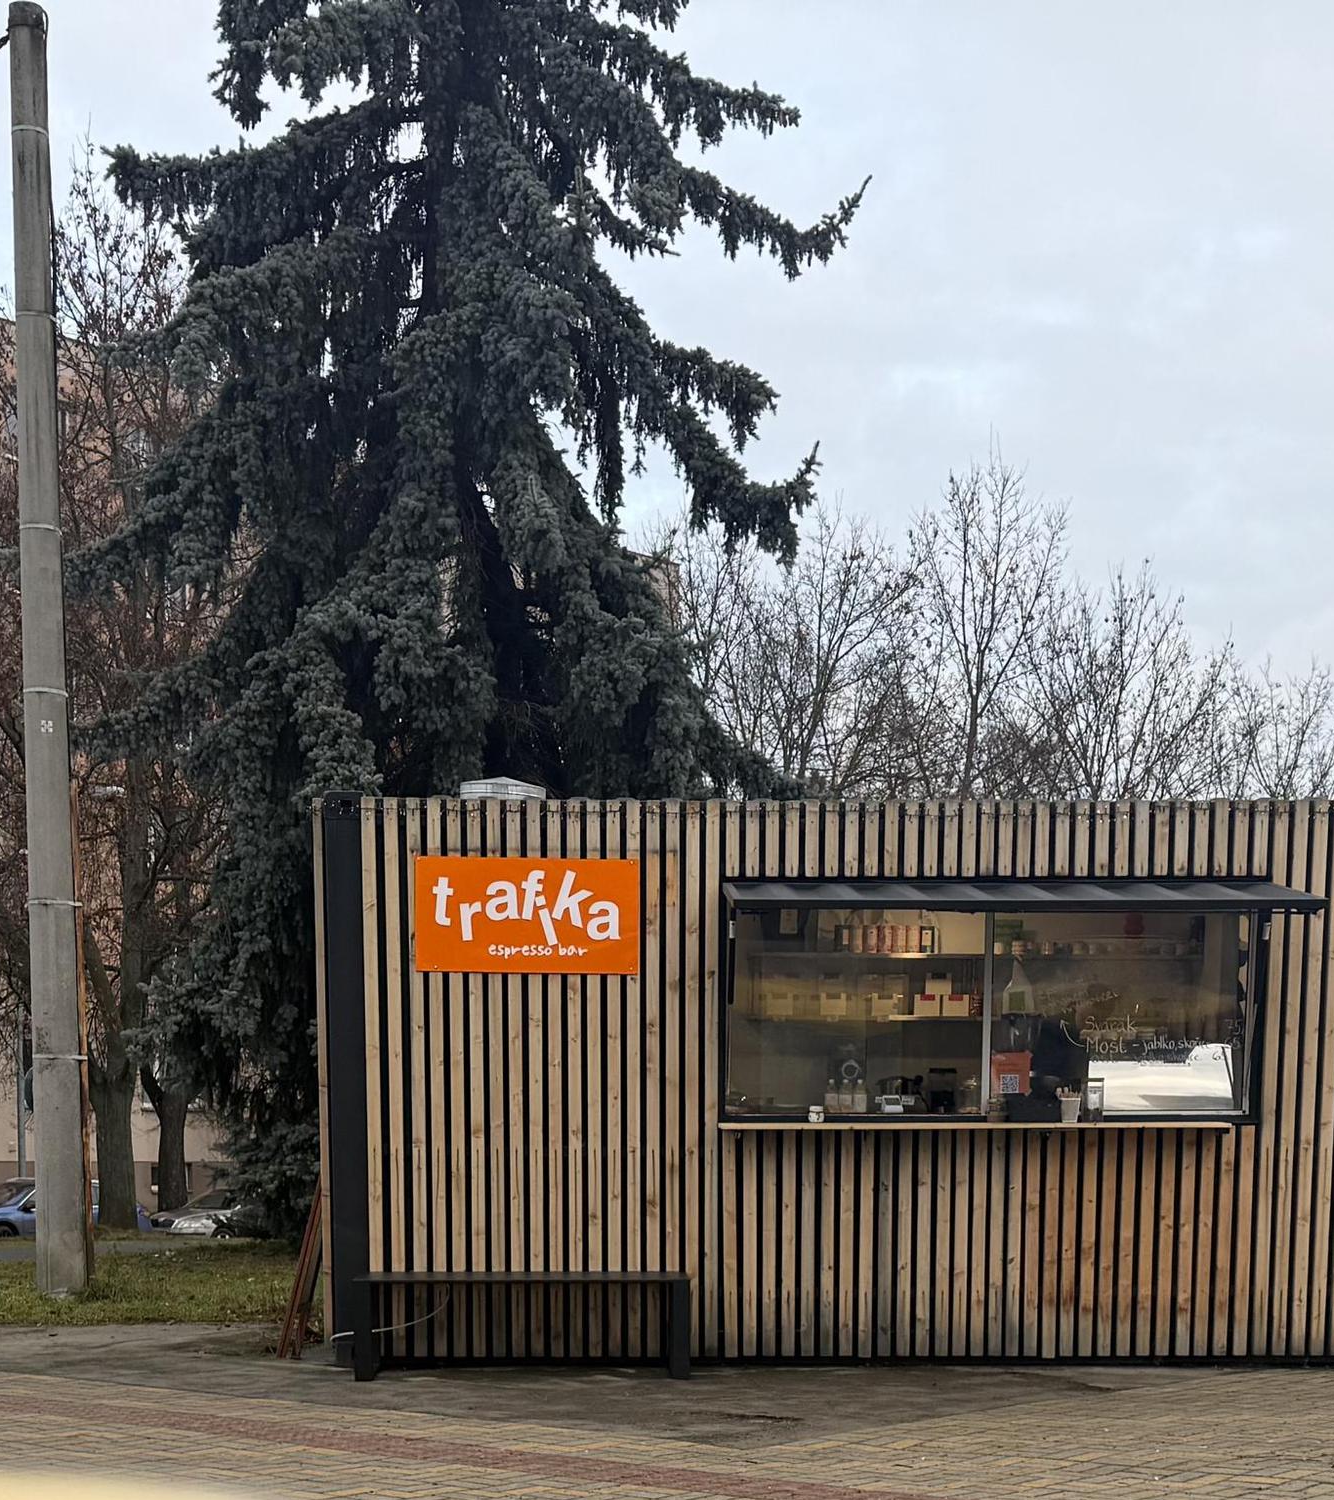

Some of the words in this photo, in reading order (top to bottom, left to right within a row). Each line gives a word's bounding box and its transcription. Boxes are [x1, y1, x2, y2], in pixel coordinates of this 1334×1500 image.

[432, 869, 621, 945] trafika
[488, 942, 553, 958] espresso
[558, 943, 588, 957] bar
